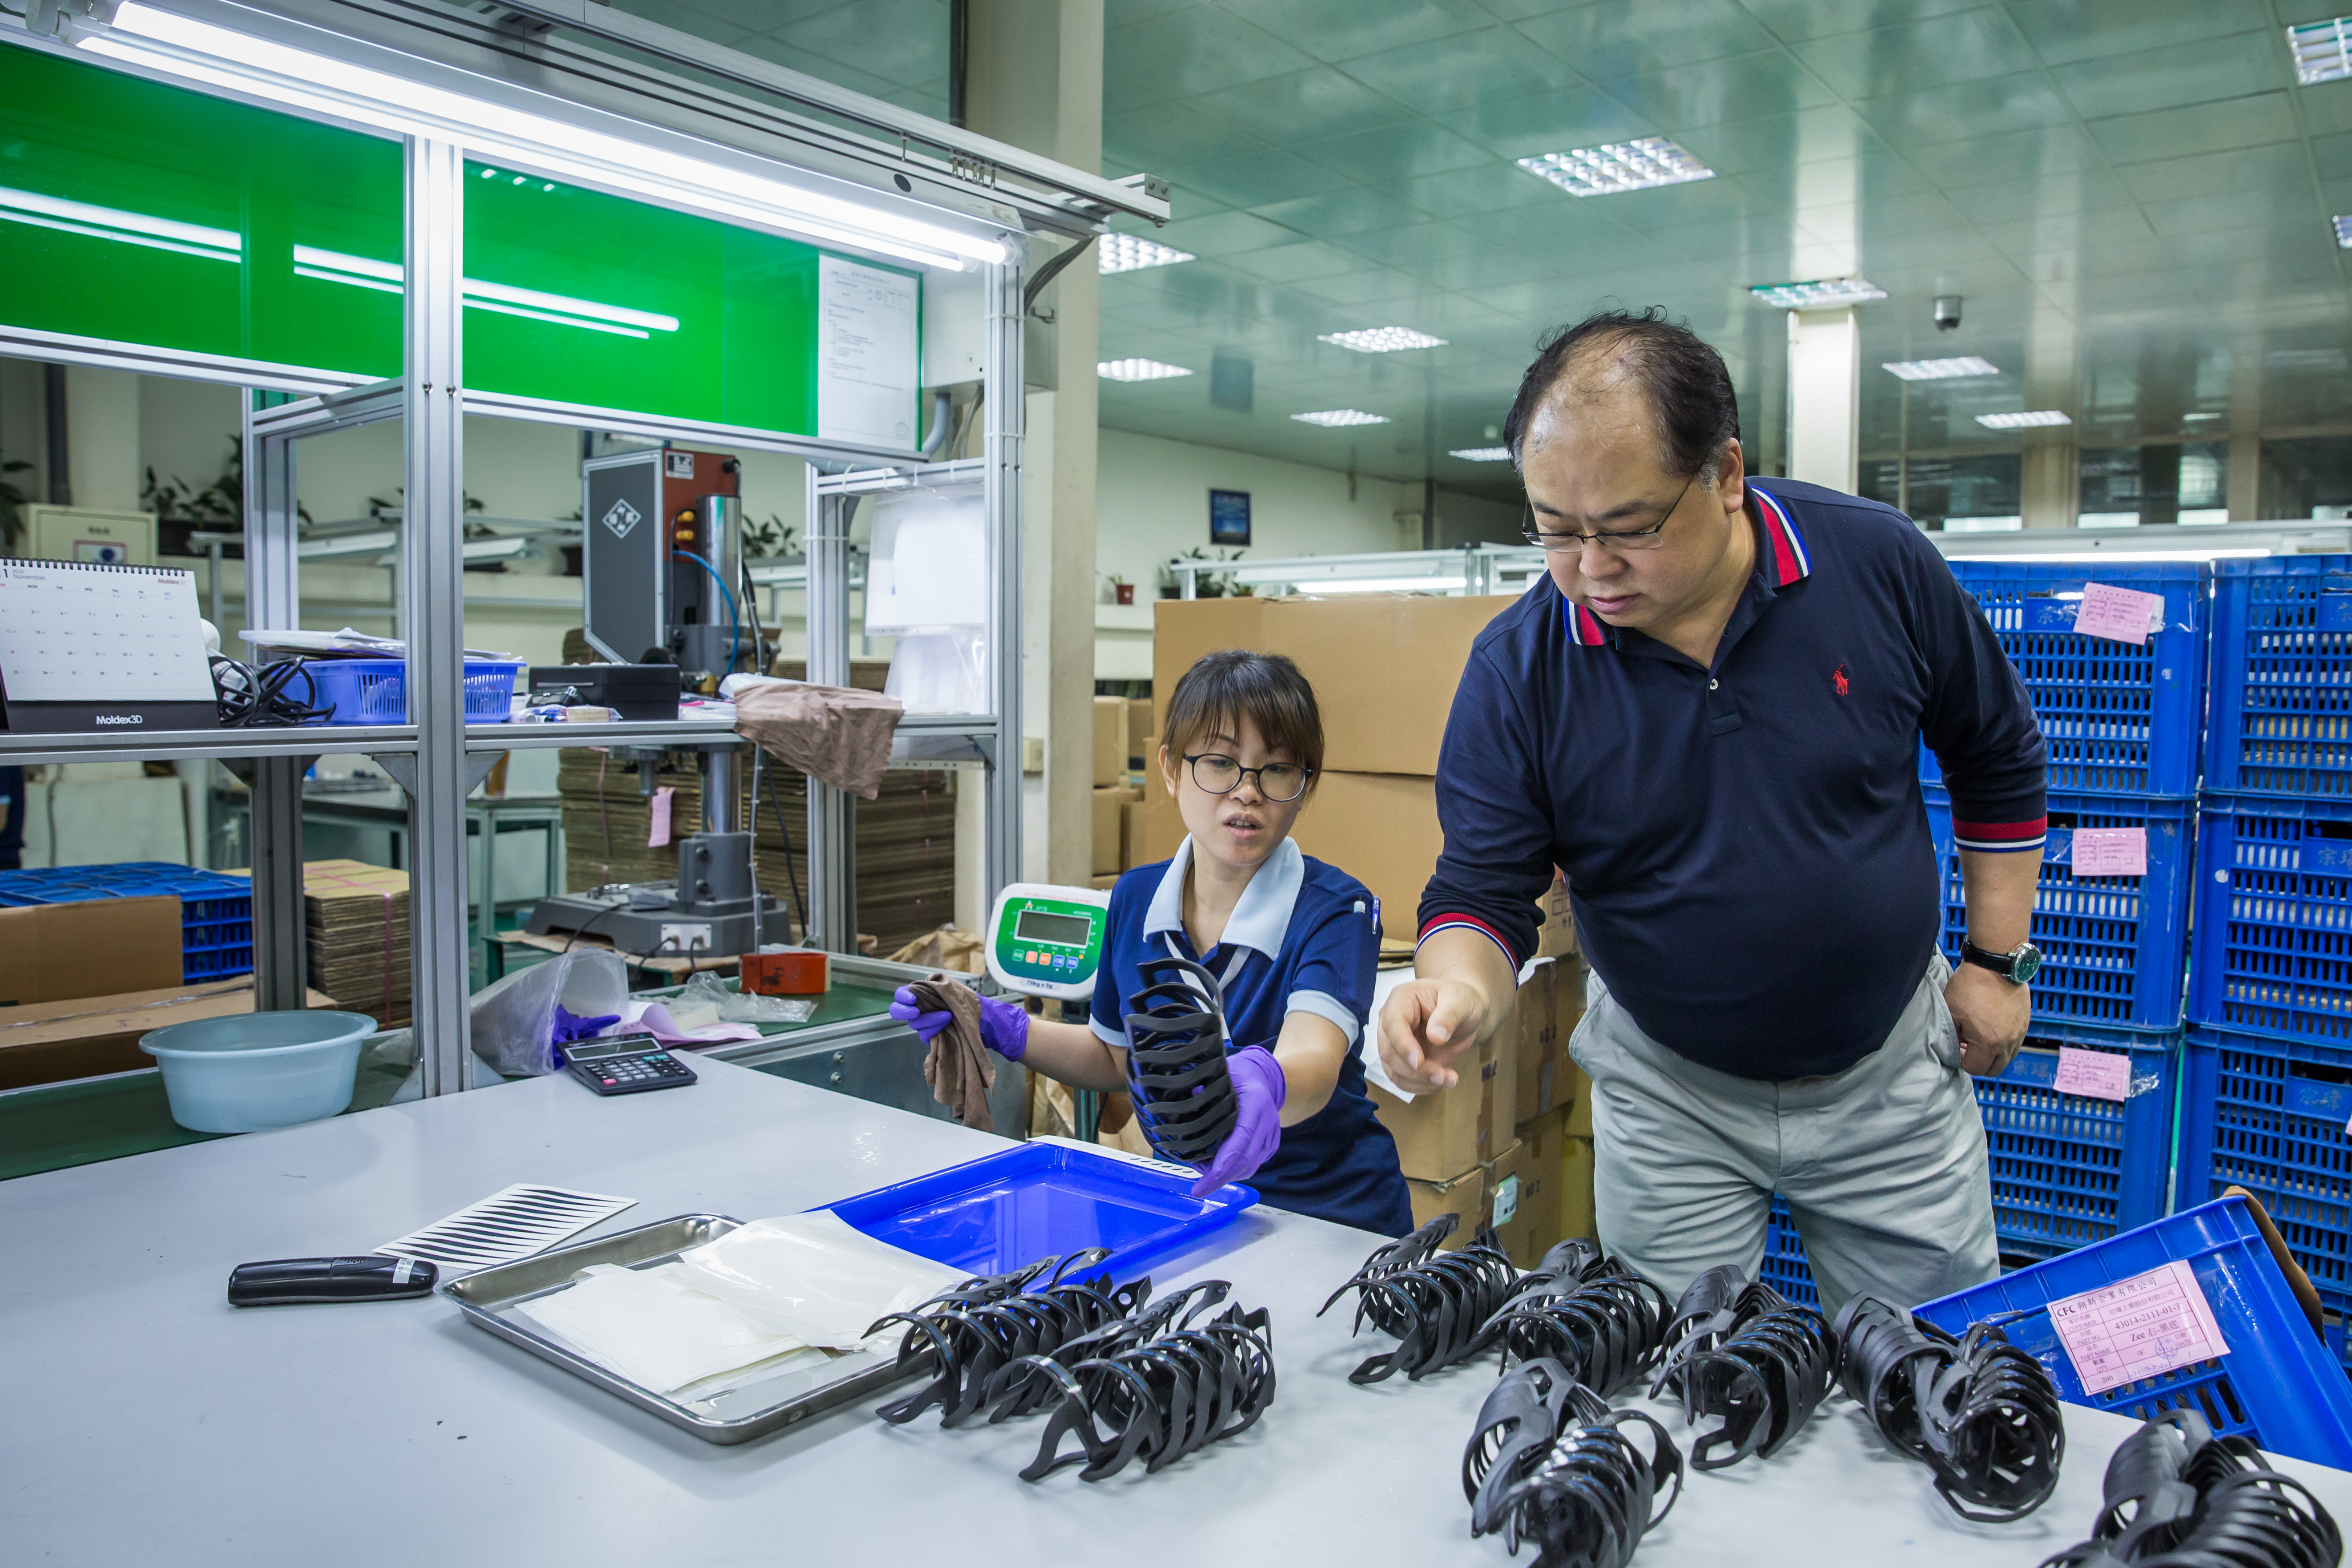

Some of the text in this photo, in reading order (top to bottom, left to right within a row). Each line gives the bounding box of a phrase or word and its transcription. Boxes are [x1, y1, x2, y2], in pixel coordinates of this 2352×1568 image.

[0, 568, 8, 578] 1
[96, 714, 143, 725] Moldex3D
[2055, 1277, 2158, 1317] CFC 朔新企業有限公司
[2114, 1302, 2181, 1330] 43014-2111-01-3
[2067, 1319, 2097, 1332] CUSTOMER
[2129, 1330, 2146, 1341] Zee
[2076, 1338, 2091, 1346] PART
[2086, 1343, 2098, 1351] 品名
[2176, 1338, 2192, 1347] DATE
[2080, 1347, 2111, 1361] PART NAME
[2100, 1375, 2114, 1383] 200
